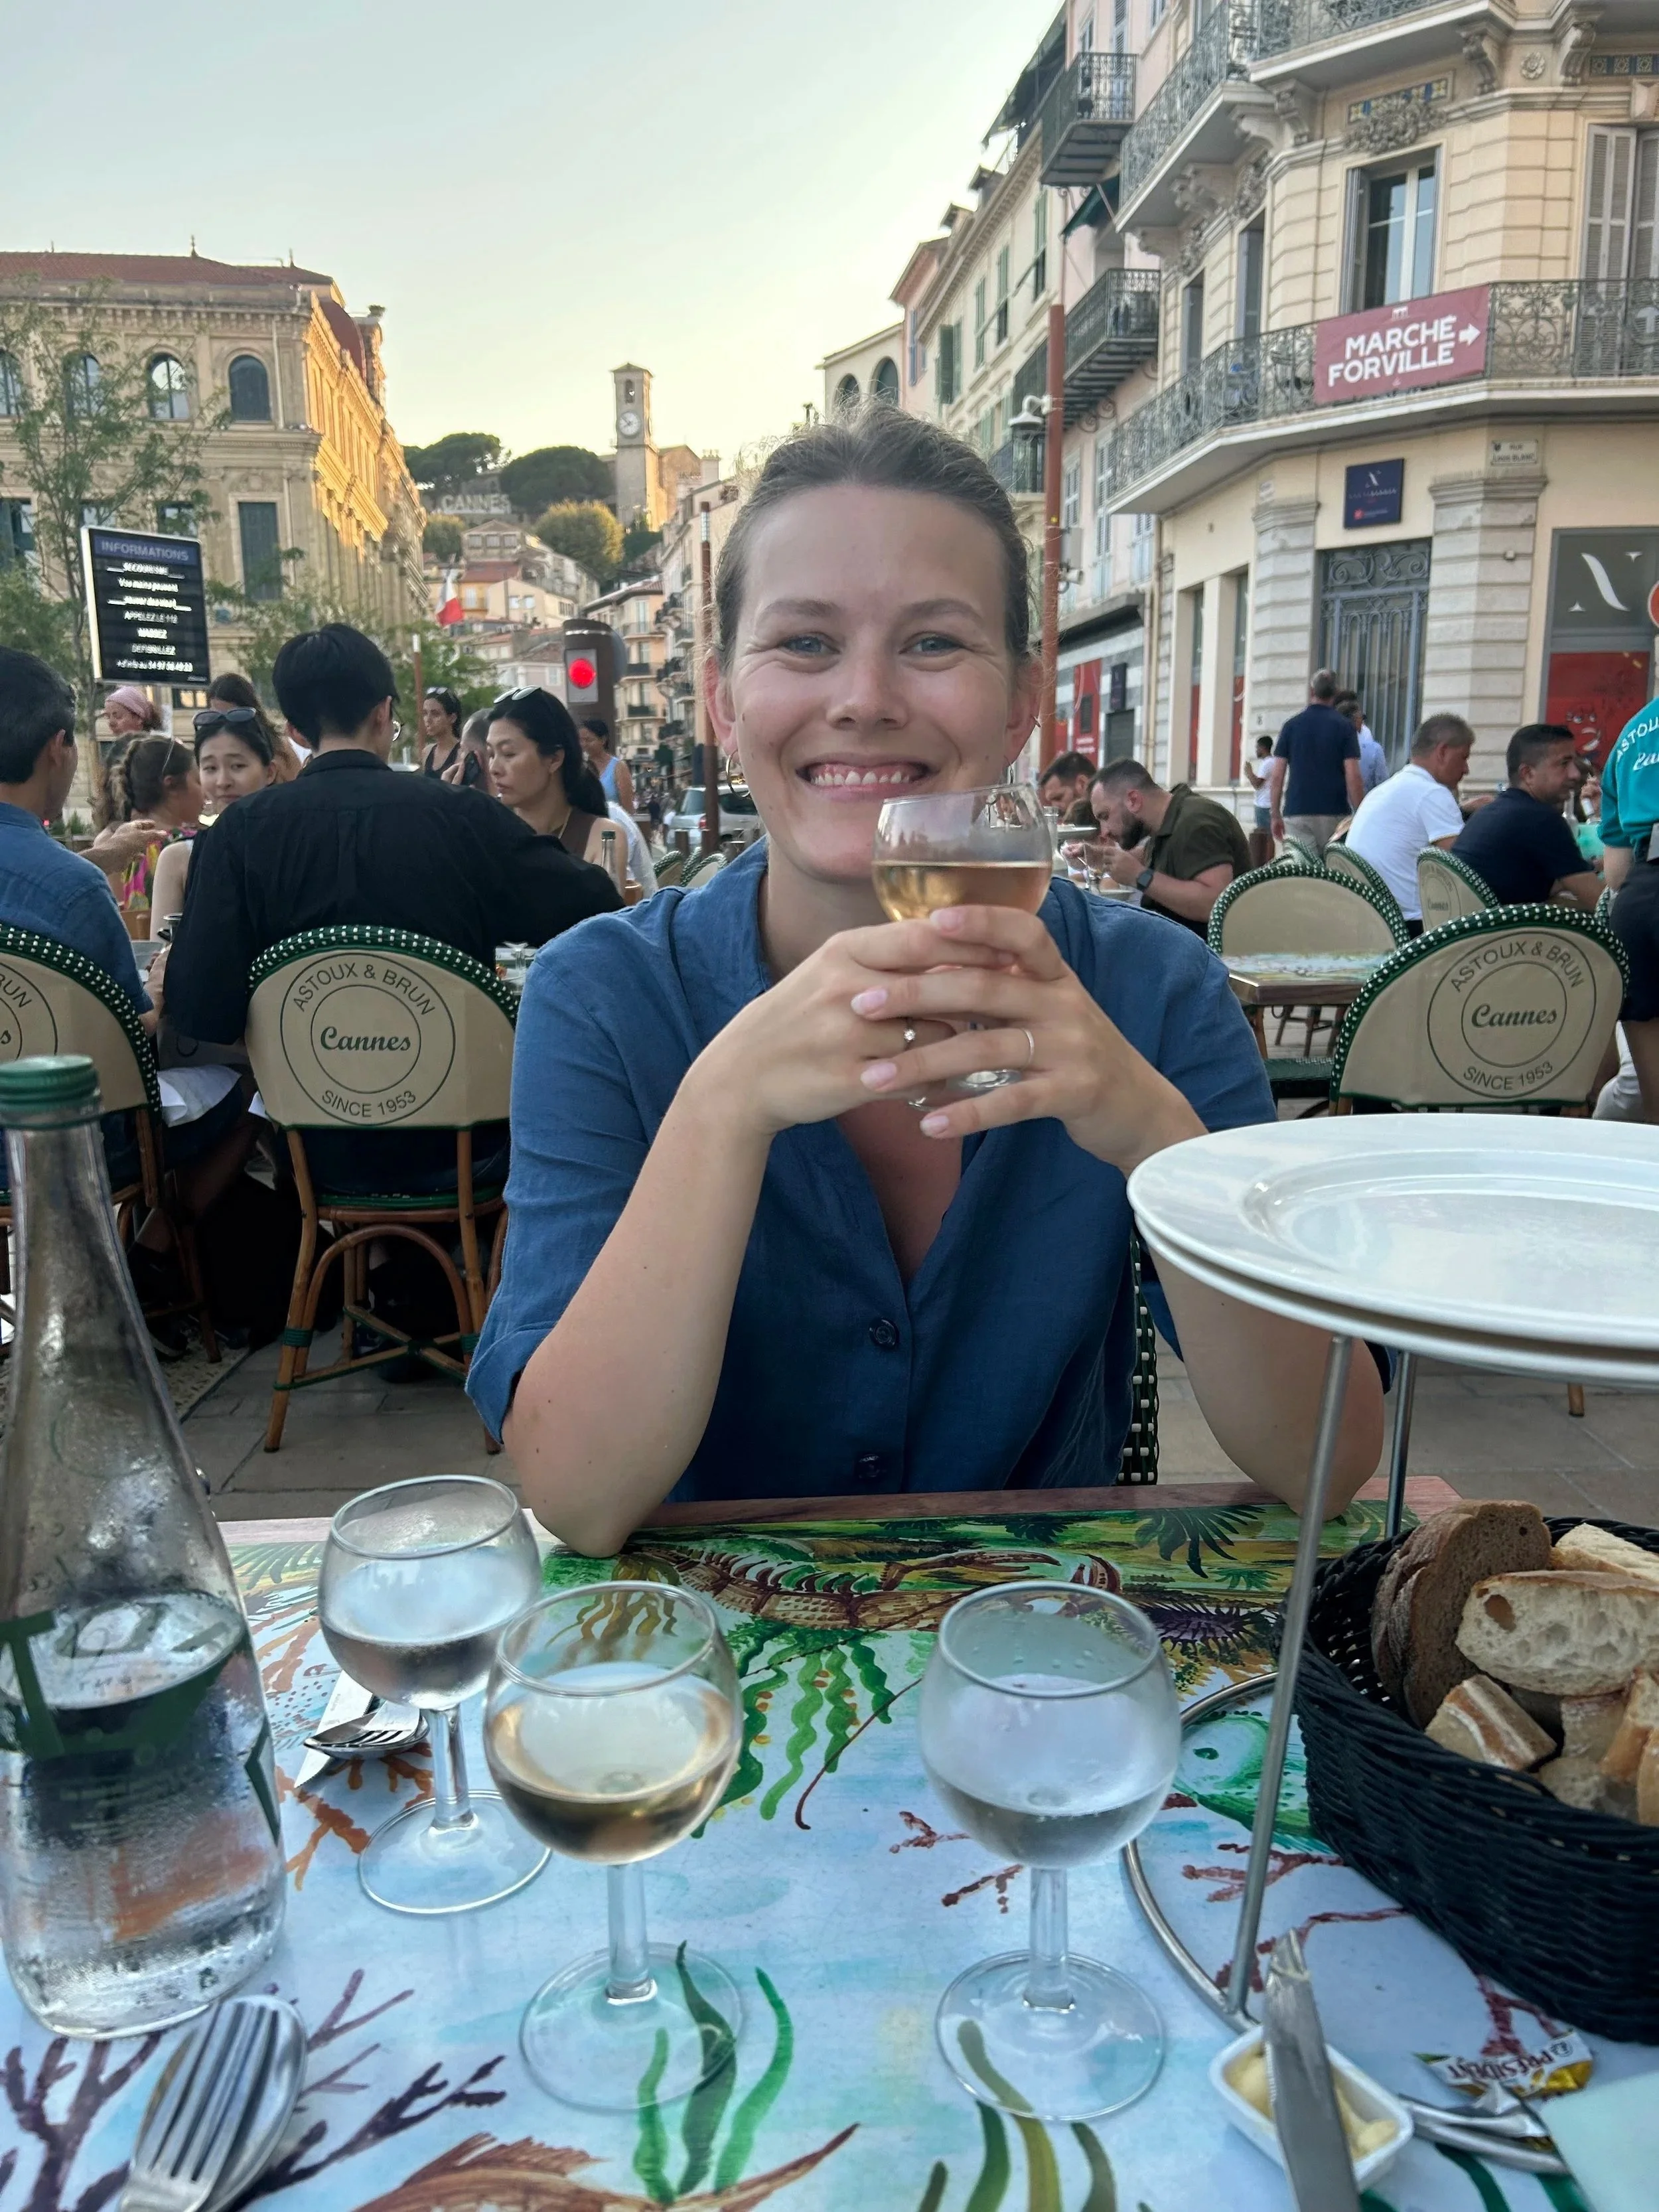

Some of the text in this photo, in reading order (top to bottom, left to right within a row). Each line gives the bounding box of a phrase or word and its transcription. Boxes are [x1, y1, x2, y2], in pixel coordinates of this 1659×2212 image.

[1328, 341, 1455, 387] FORVILLE
[441, 493, 512, 514] CANNES
[102, 541, 188, 561] INFORMATIONS
[1451, 940, 1584, 993] ASTOUX & BRUN
[293, 962, 435, 1015] ASTOUX & BRUN
[1471, 1003, 1557, 1028] Cannes
[321, 1026, 411, 1051] Cannes
[1463, 1061, 1553, 1090] SINCE 1953
[322, 1090, 416, 1118] SINCE 1953
